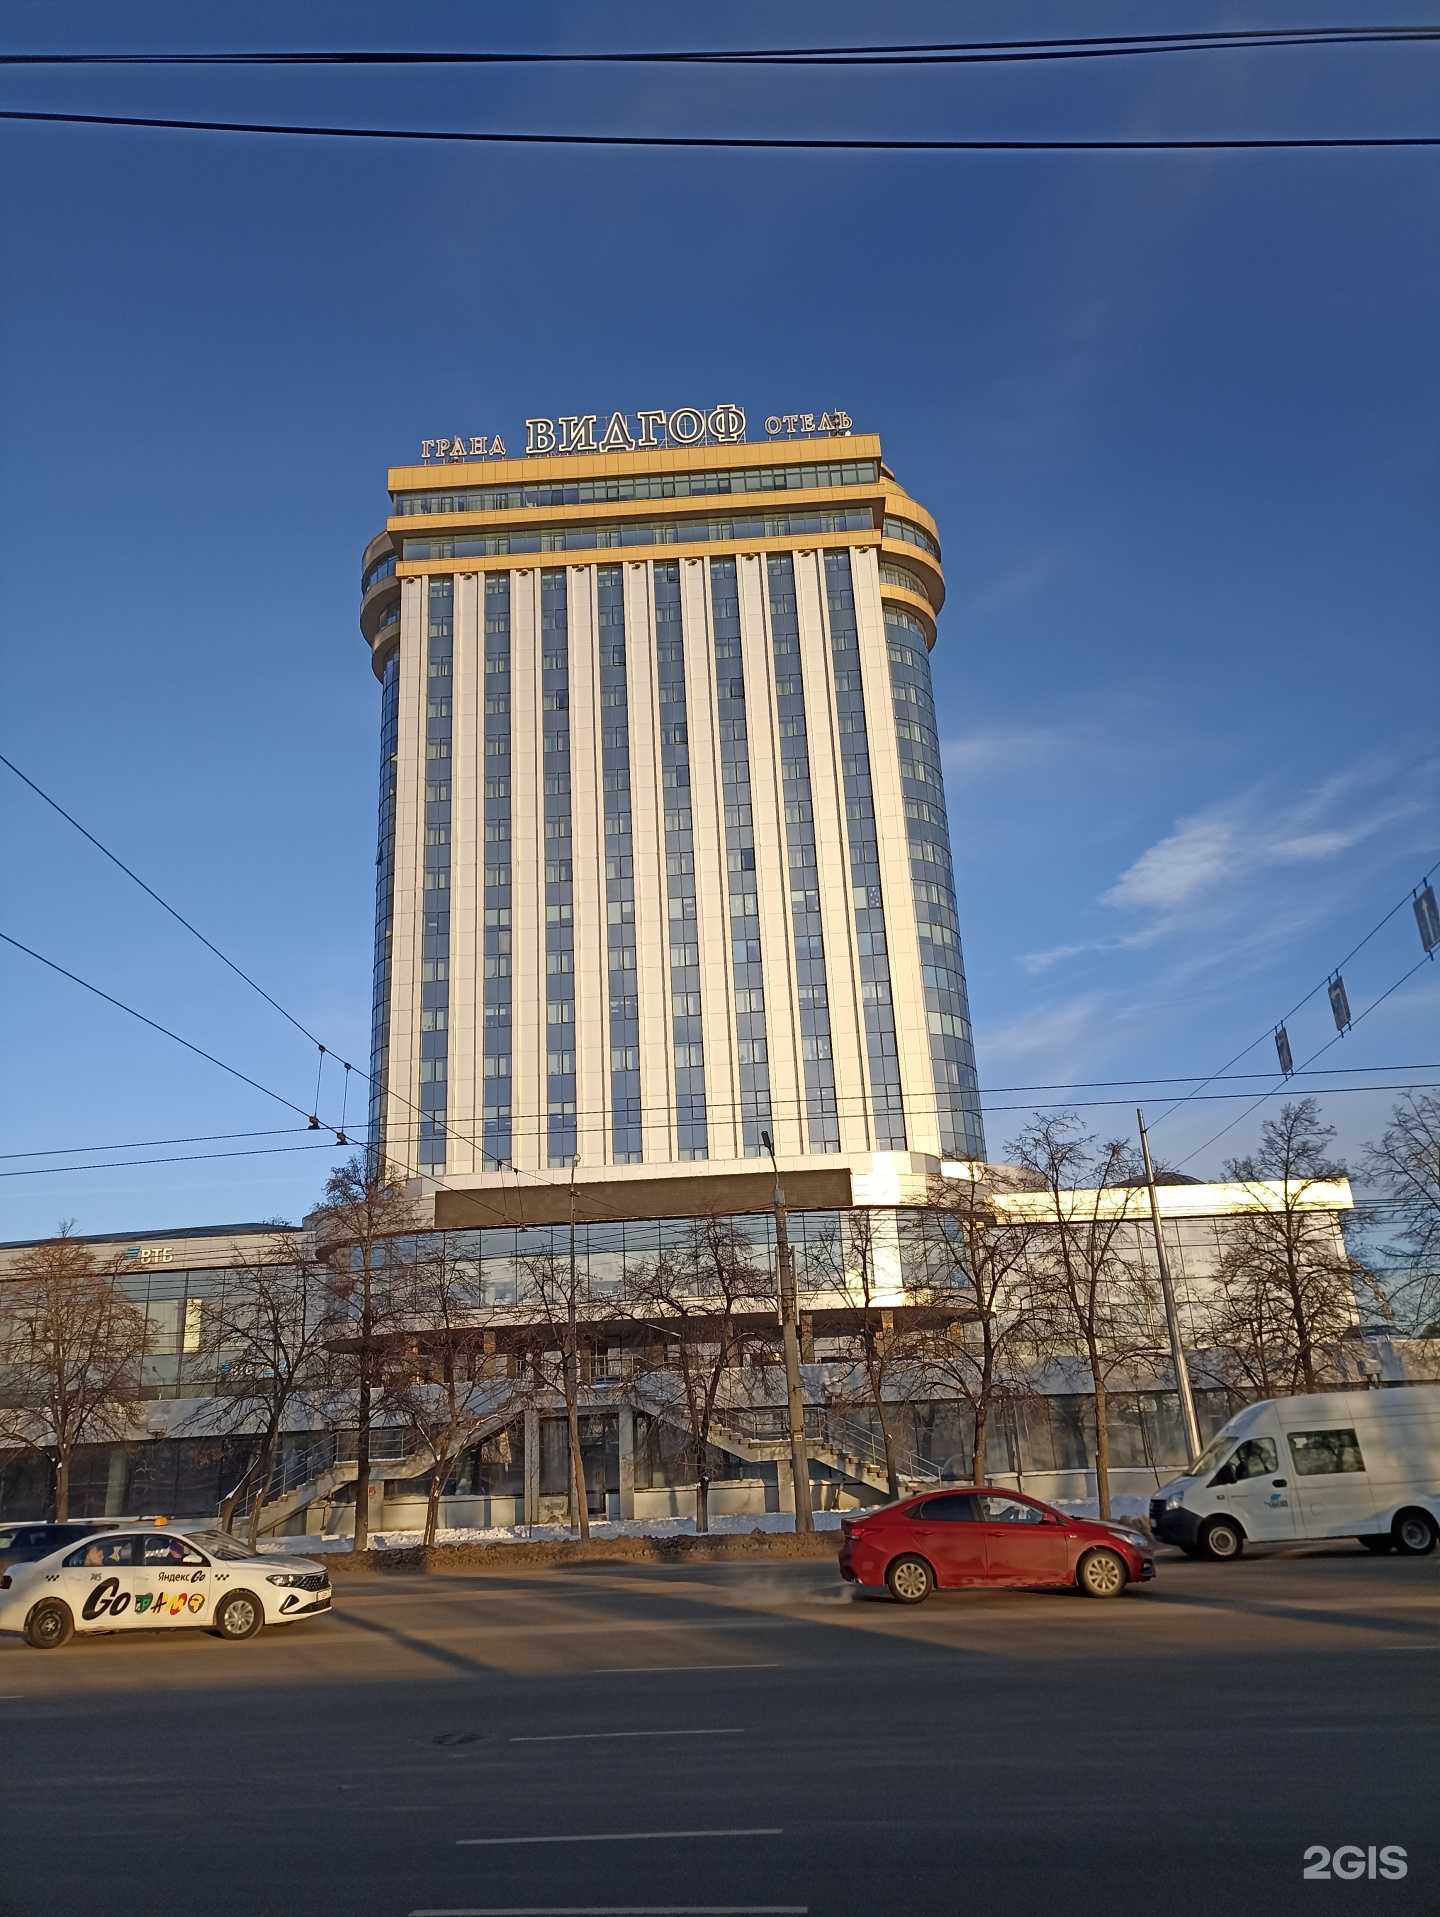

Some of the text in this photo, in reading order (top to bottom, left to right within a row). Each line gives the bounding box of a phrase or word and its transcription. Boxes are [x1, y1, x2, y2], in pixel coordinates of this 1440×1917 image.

[421, 404, 853, 458] ГРАНД ВИДГОФ ОТЕЛЬ
[140, 1247, 173, 1264] ВТБ
[158, 1570, 206, 1583] Яндекс Go
[82, 1577, 131, 1621] Go
